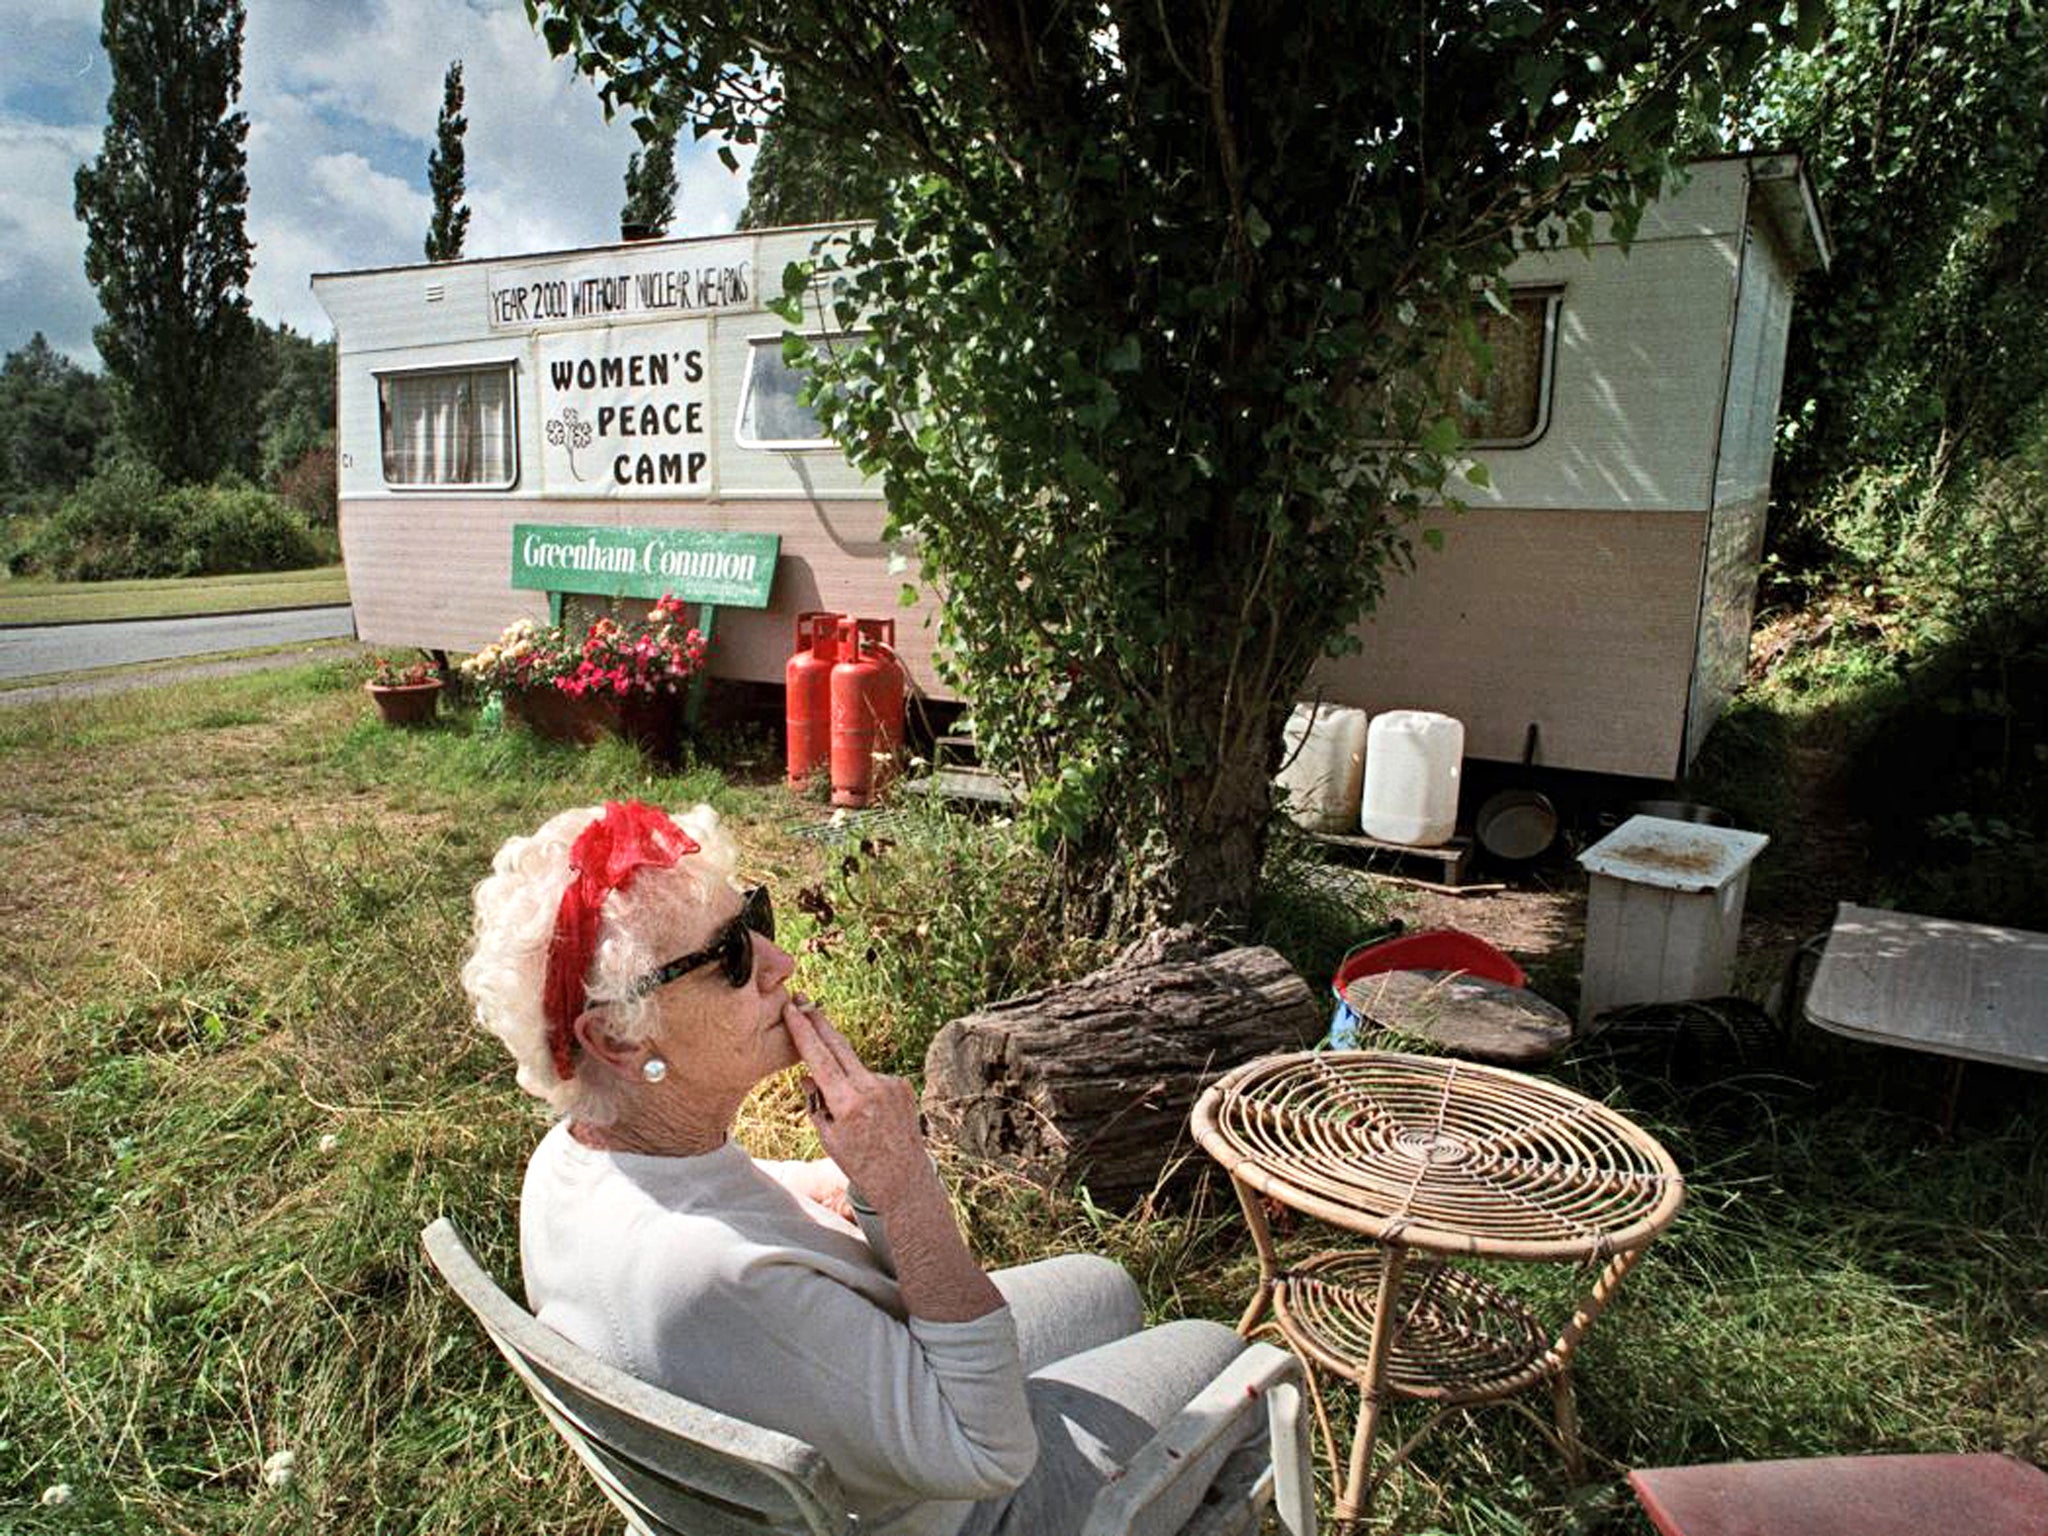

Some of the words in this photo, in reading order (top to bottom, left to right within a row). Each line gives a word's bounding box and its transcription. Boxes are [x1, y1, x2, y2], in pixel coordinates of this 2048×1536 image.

[492, 287, 528, 322] YEAR
[532, 280, 568, 318] 2000
[571, 275, 630, 316] WITHOUT
[635, 270, 691, 309] NUCLEAR
[696, 260, 749, 306] WEAPONS
[551, 350, 704, 391] WOMEN'S
[598, 402, 704, 437] PEACE
[613, 451, 707, 486] CAMP
[523, 533, 637, 573] Greenham
[643, 540, 757, 581] Common
